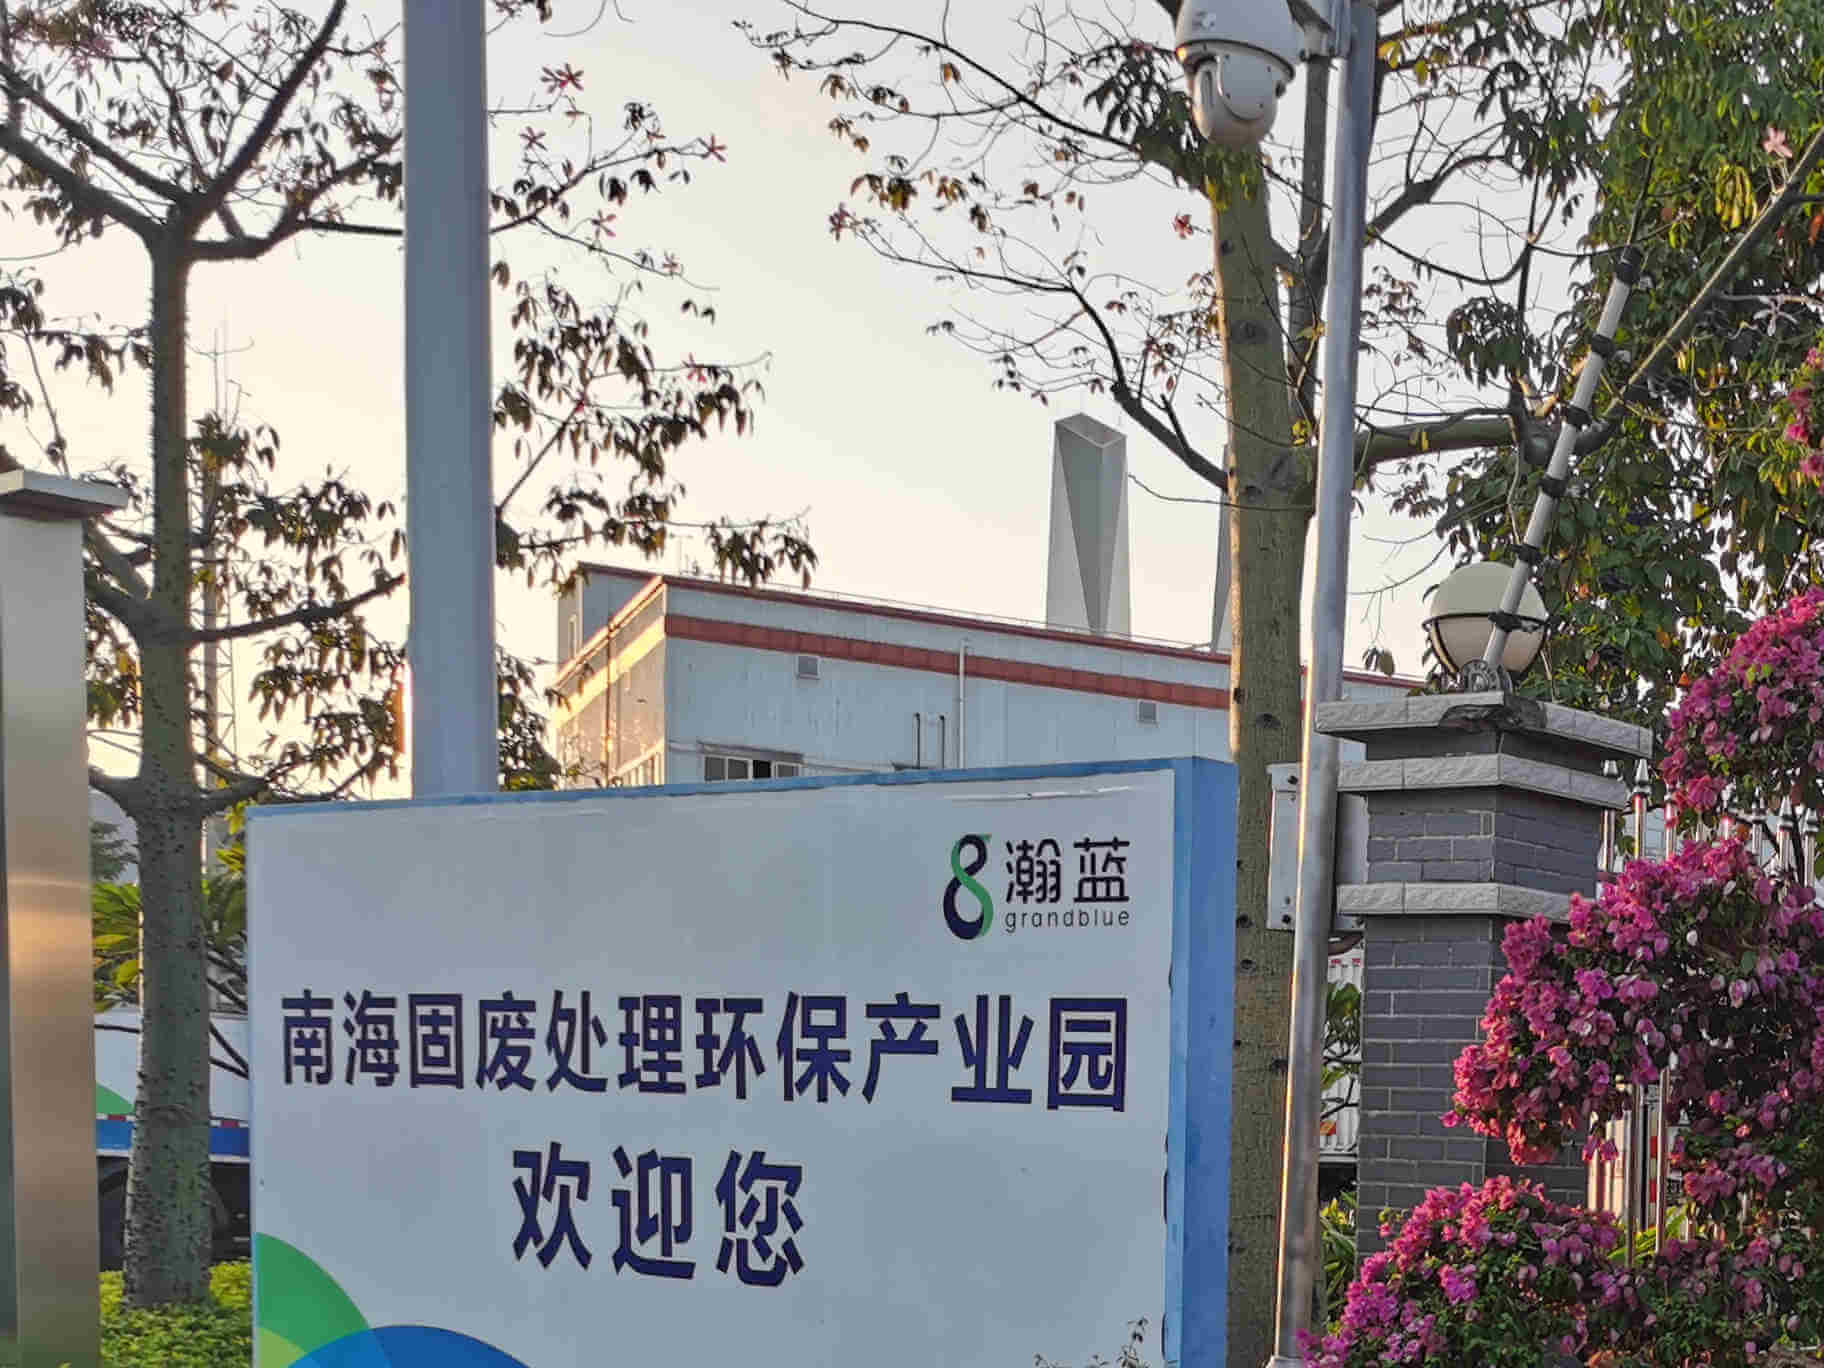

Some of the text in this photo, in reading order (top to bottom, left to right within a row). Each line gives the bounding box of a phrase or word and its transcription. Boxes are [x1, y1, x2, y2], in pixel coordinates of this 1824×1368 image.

[1005, 836, 1130, 905] 瀚蓝
[1005, 910, 1130, 934] grandblue
[281, 988, 1128, 1113] 南海固废处理环保产业园
[512, 1141, 805, 1288] 欢迎您
